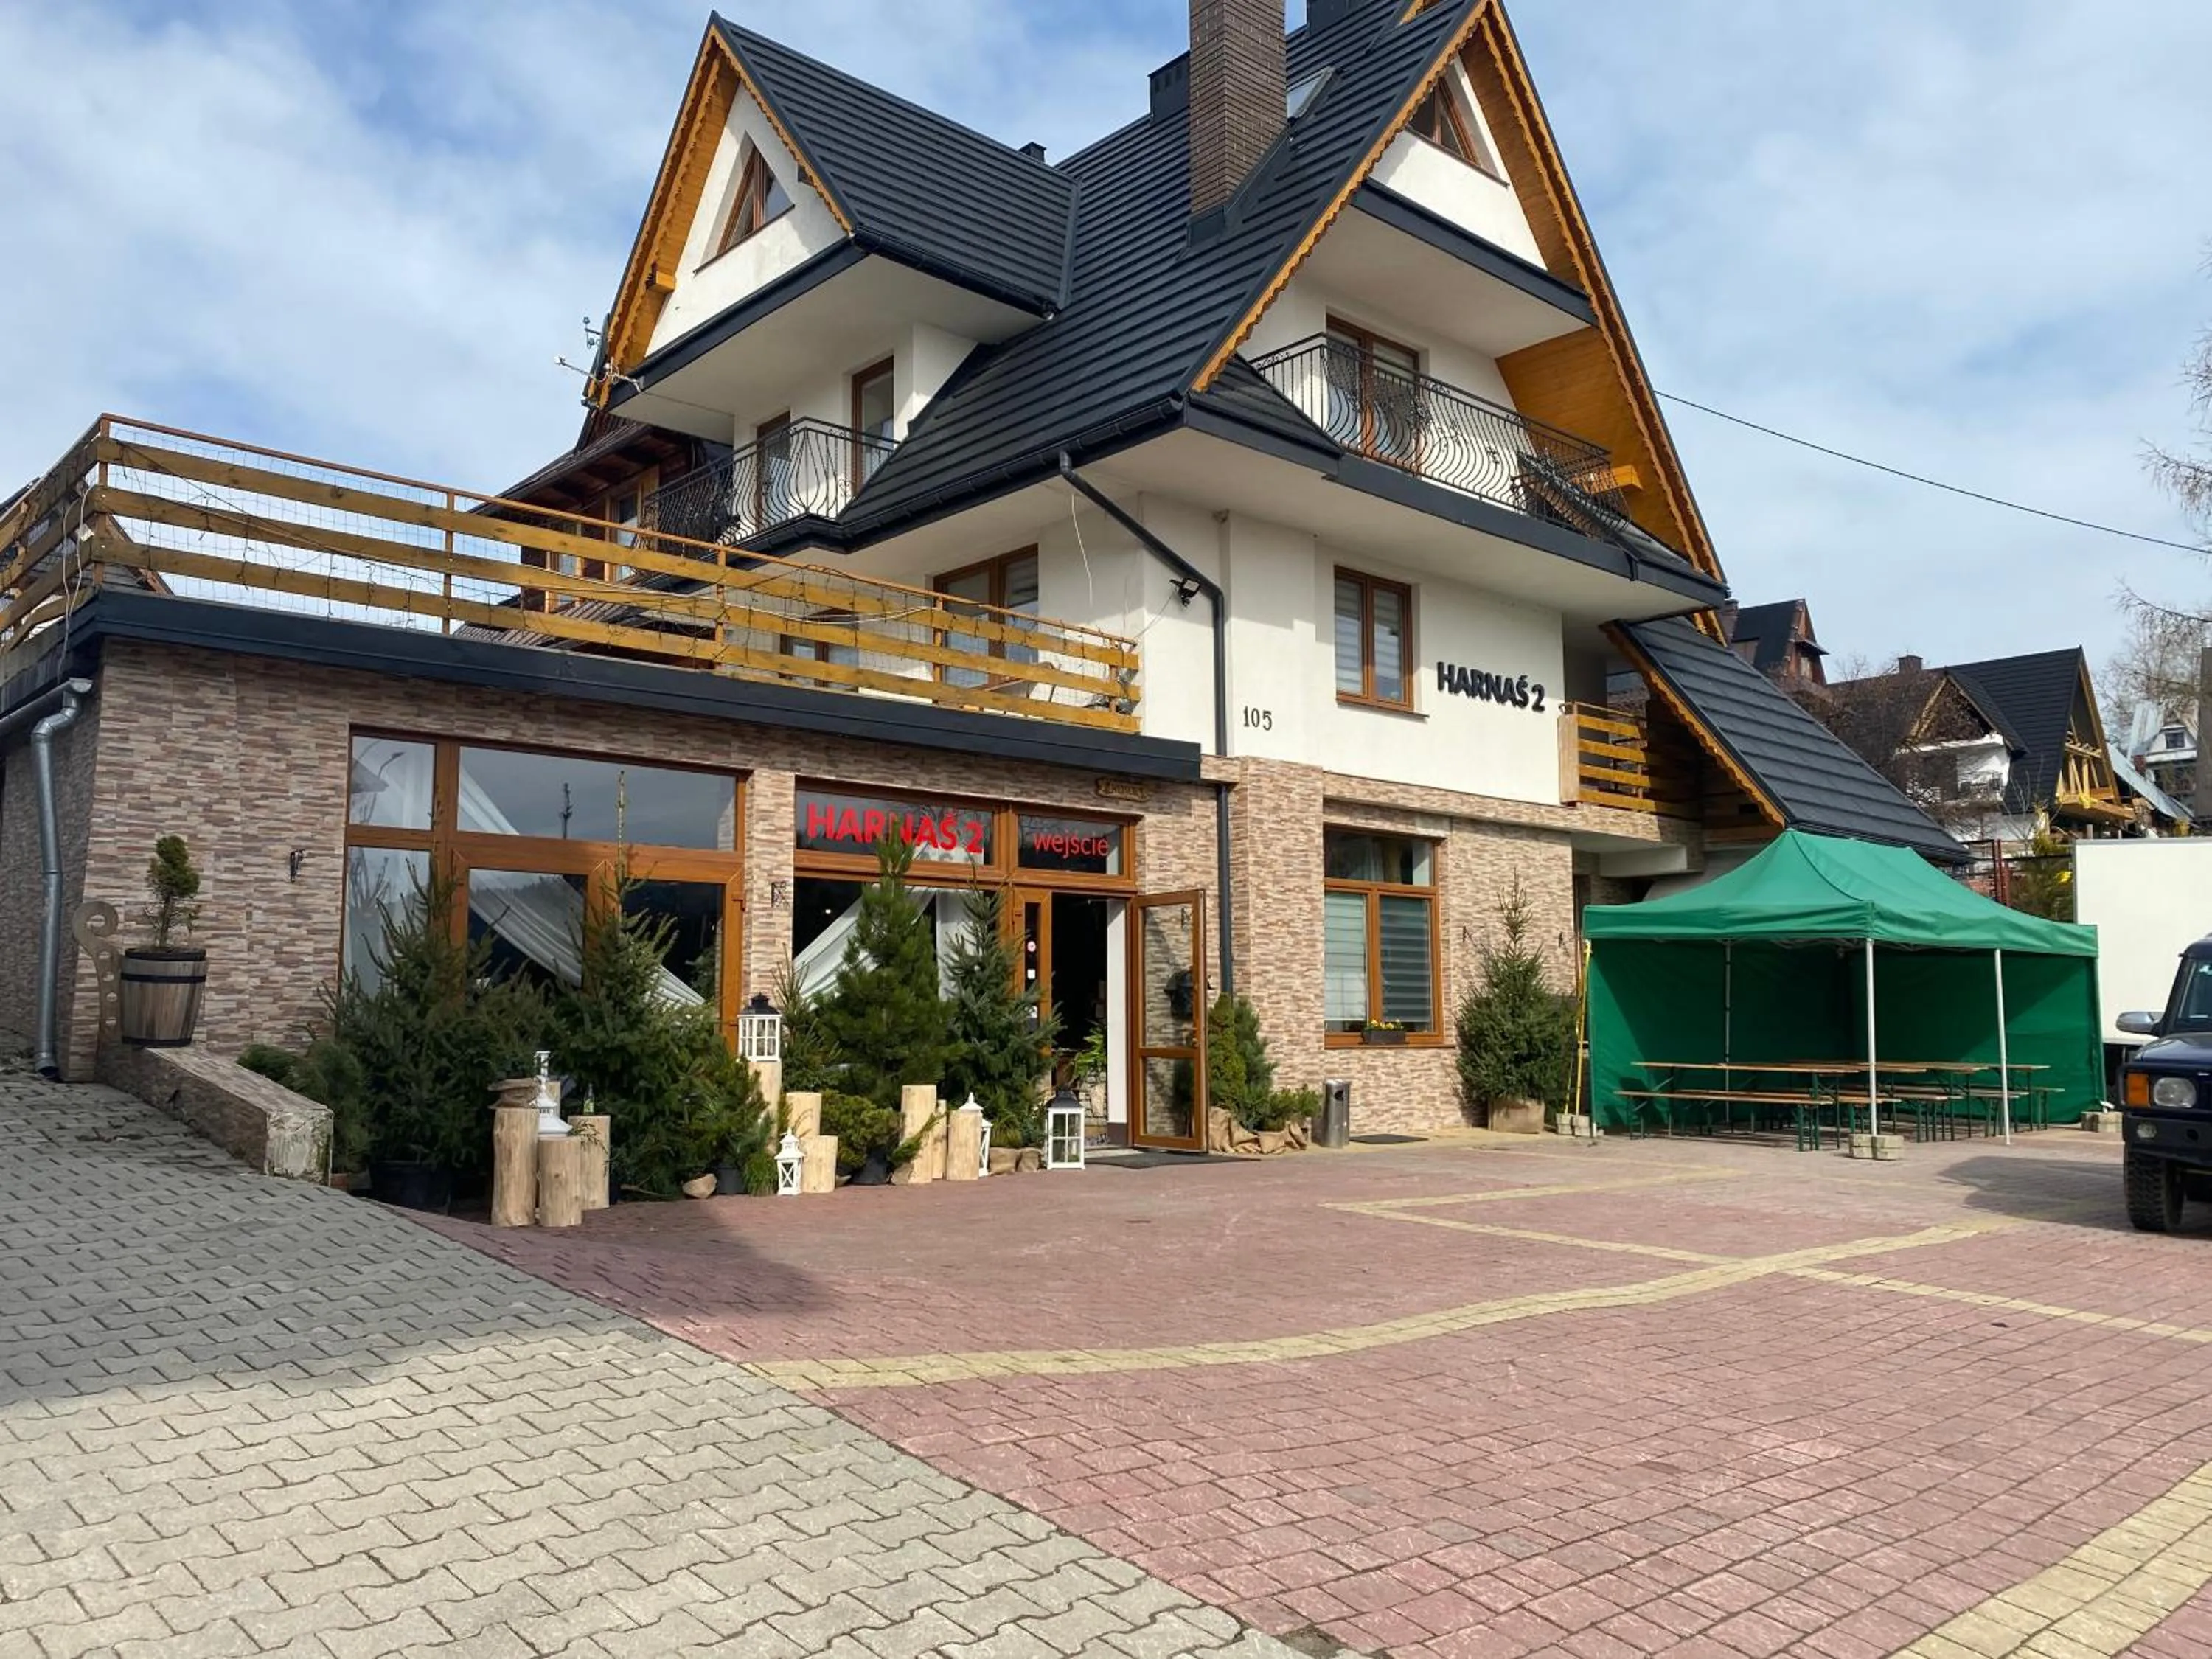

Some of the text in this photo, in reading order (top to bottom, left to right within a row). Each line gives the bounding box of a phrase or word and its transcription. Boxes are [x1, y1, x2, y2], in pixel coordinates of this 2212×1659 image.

[1437, 661, 1545, 712] HARNAŚ 2
[1243, 706, 1272, 731] 105
[964, 821, 984, 854] 2
[1034, 830, 1110, 859] wejście
